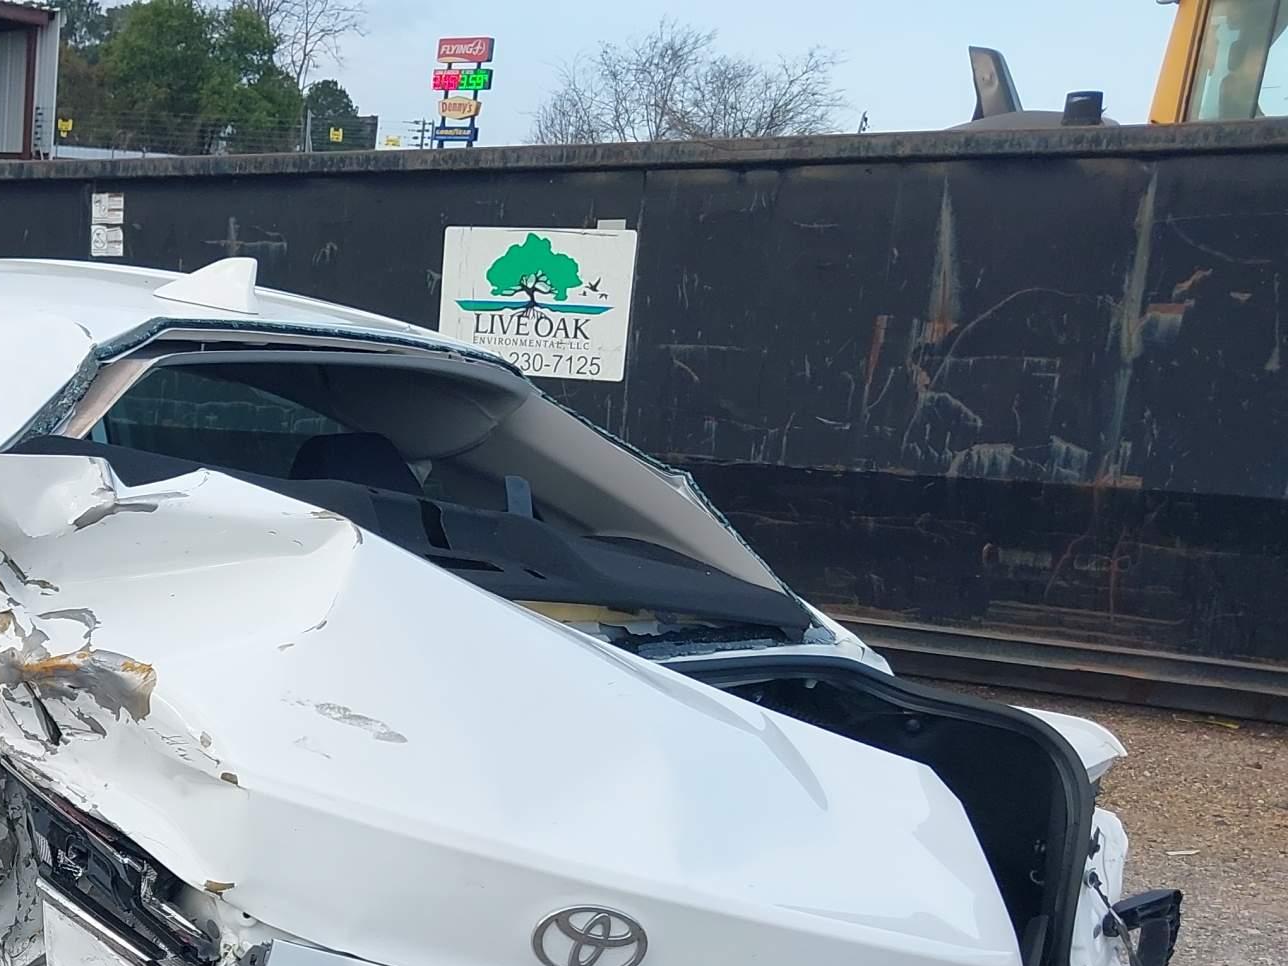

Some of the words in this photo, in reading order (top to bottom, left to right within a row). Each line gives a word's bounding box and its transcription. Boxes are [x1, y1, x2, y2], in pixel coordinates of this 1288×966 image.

[440, 43, 474, 55] FLYING
[441, 102, 473, 114] Denny's
[474, 312, 530, 336] LIVE
[534, 316, 591, 340] OAK
[569, 341, 590, 350] LLC
